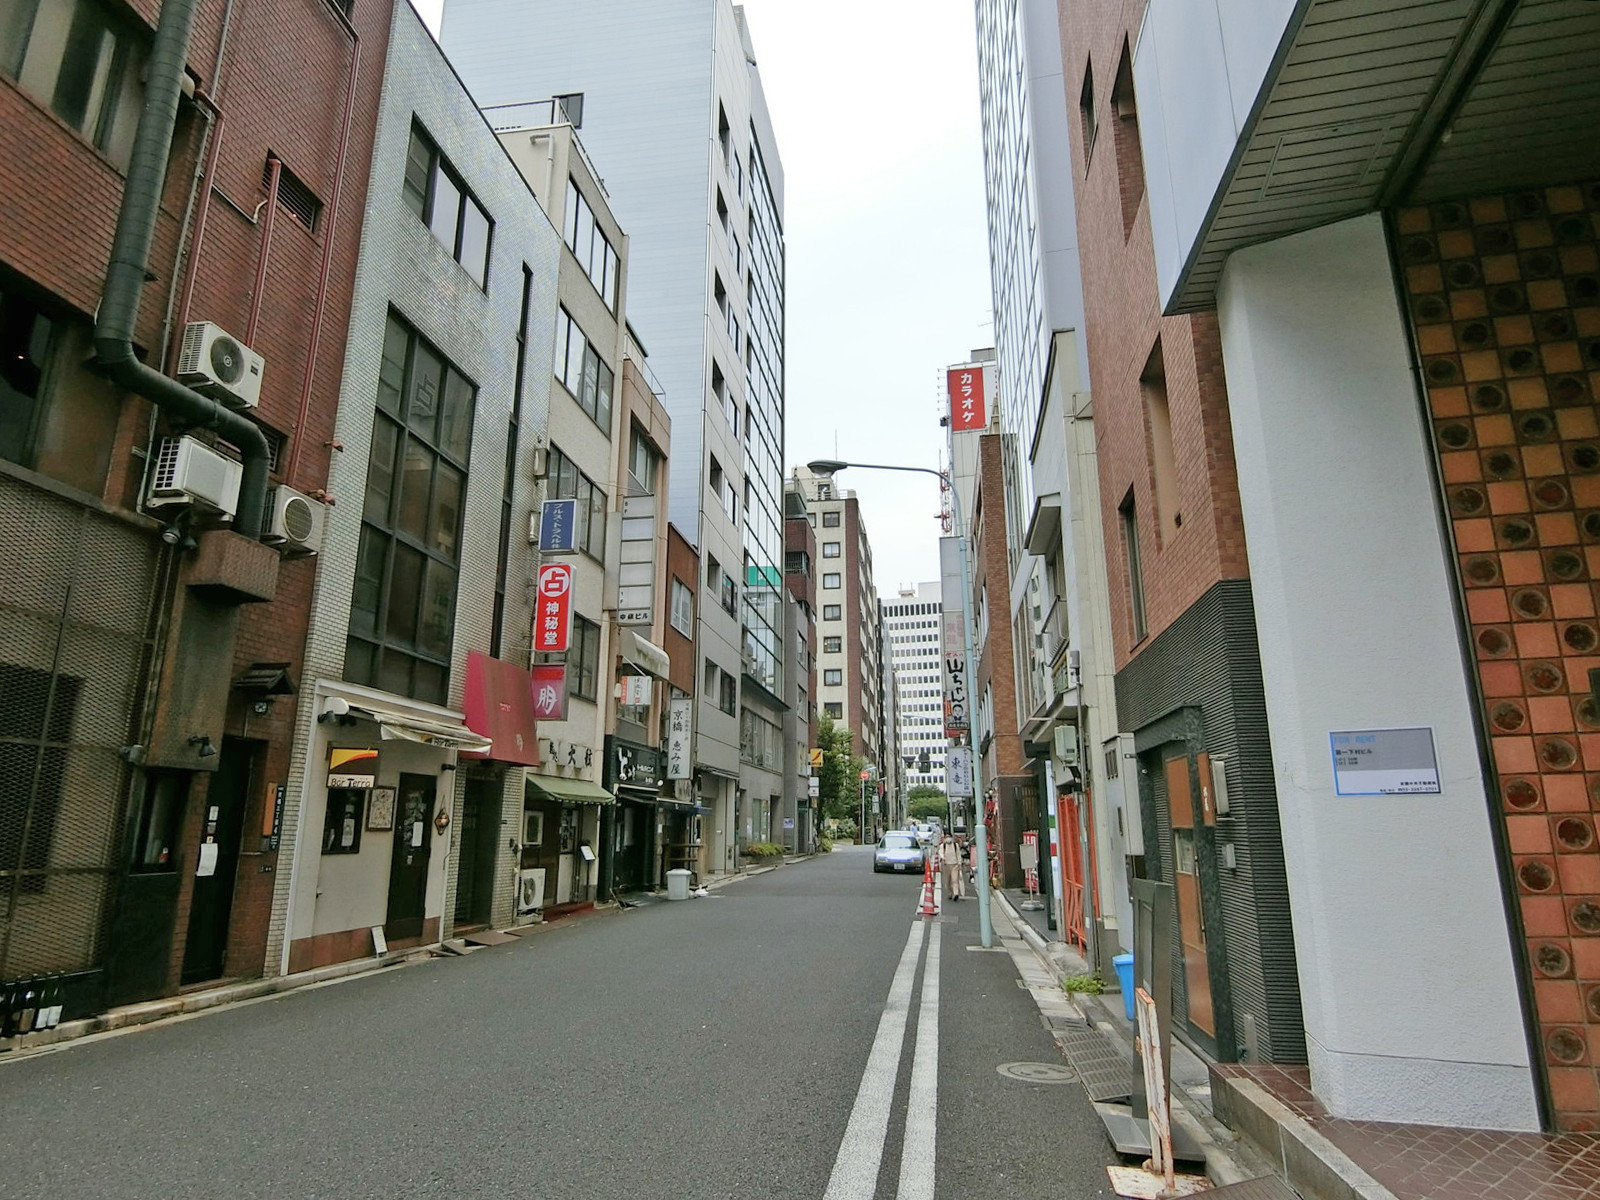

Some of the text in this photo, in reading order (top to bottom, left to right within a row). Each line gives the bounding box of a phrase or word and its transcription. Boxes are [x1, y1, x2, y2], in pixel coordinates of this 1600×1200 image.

[961, 373, 975, 422] カラオケ
[544, 571, 565, 593] 占
[544, 601, 560, 645] 神秘堂
[537, 685, 558, 715] 朋
[946, 658, 965, 703] 山ちゃん
[670, 710, 684, 775] 京橋 恵み屋
[331, 778, 370, 788] Bar Terra
